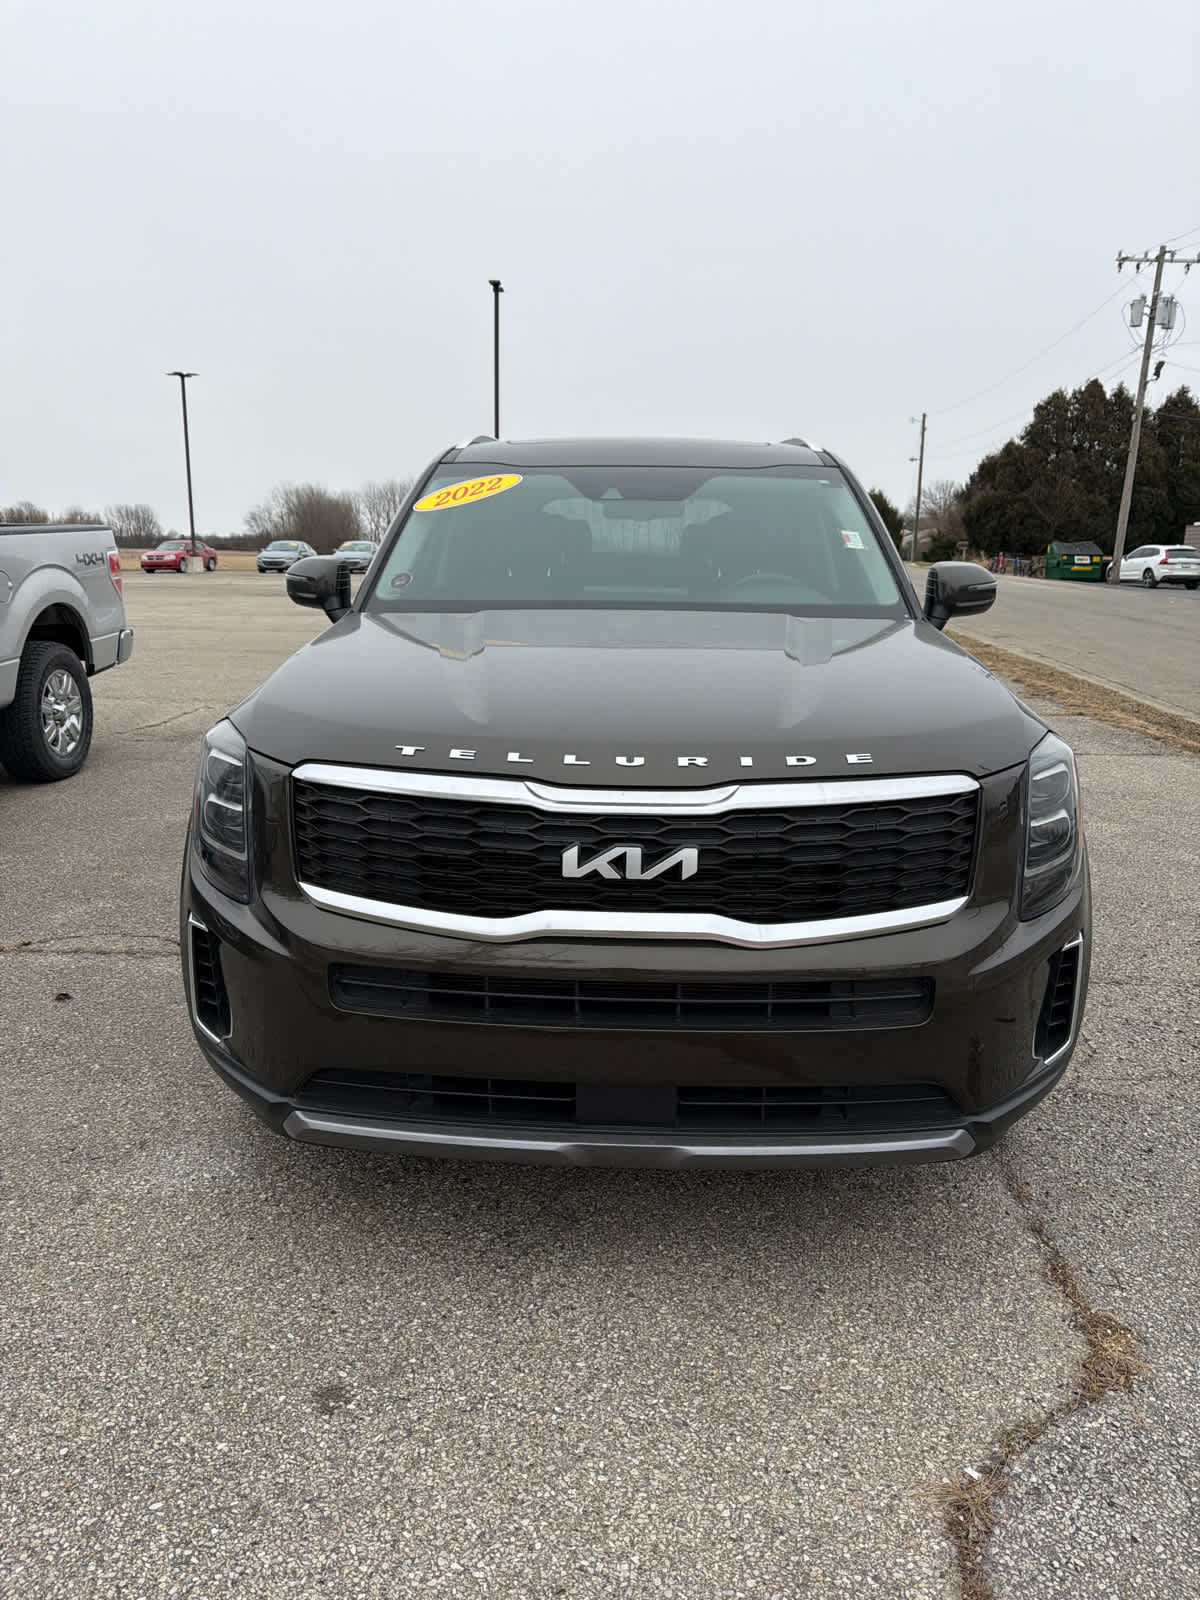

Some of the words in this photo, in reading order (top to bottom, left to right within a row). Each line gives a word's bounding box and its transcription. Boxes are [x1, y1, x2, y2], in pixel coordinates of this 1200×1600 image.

[433, 477, 503, 507] 2022
[395, 745, 873, 767] TELLURIDE
[561, 845, 698, 880] KIA
